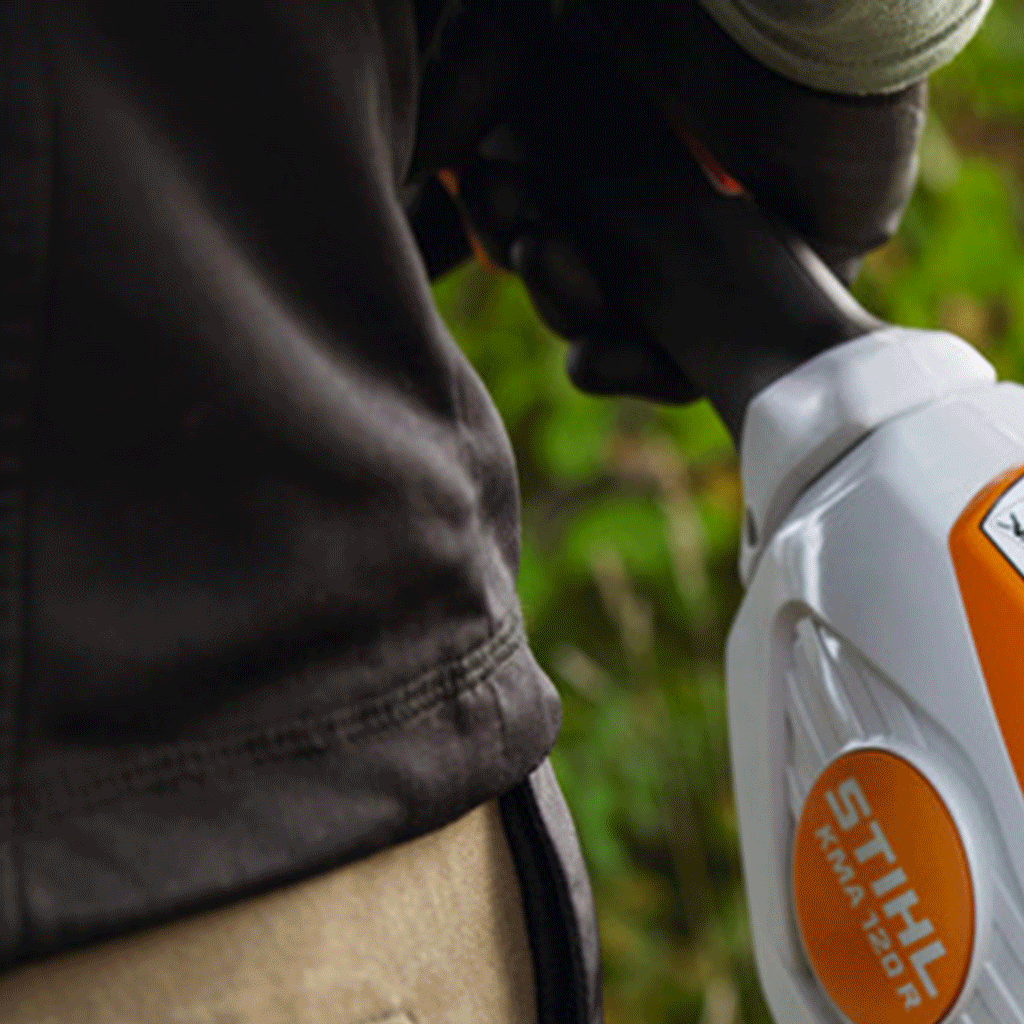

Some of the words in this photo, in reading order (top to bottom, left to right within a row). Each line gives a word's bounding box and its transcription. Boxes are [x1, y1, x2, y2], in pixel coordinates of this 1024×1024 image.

[815, 825, 865, 908] KMA
[862, 911, 905, 978] 120
[896, 983, 922, 1009] R
[824, 777, 947, 998] STIHL
